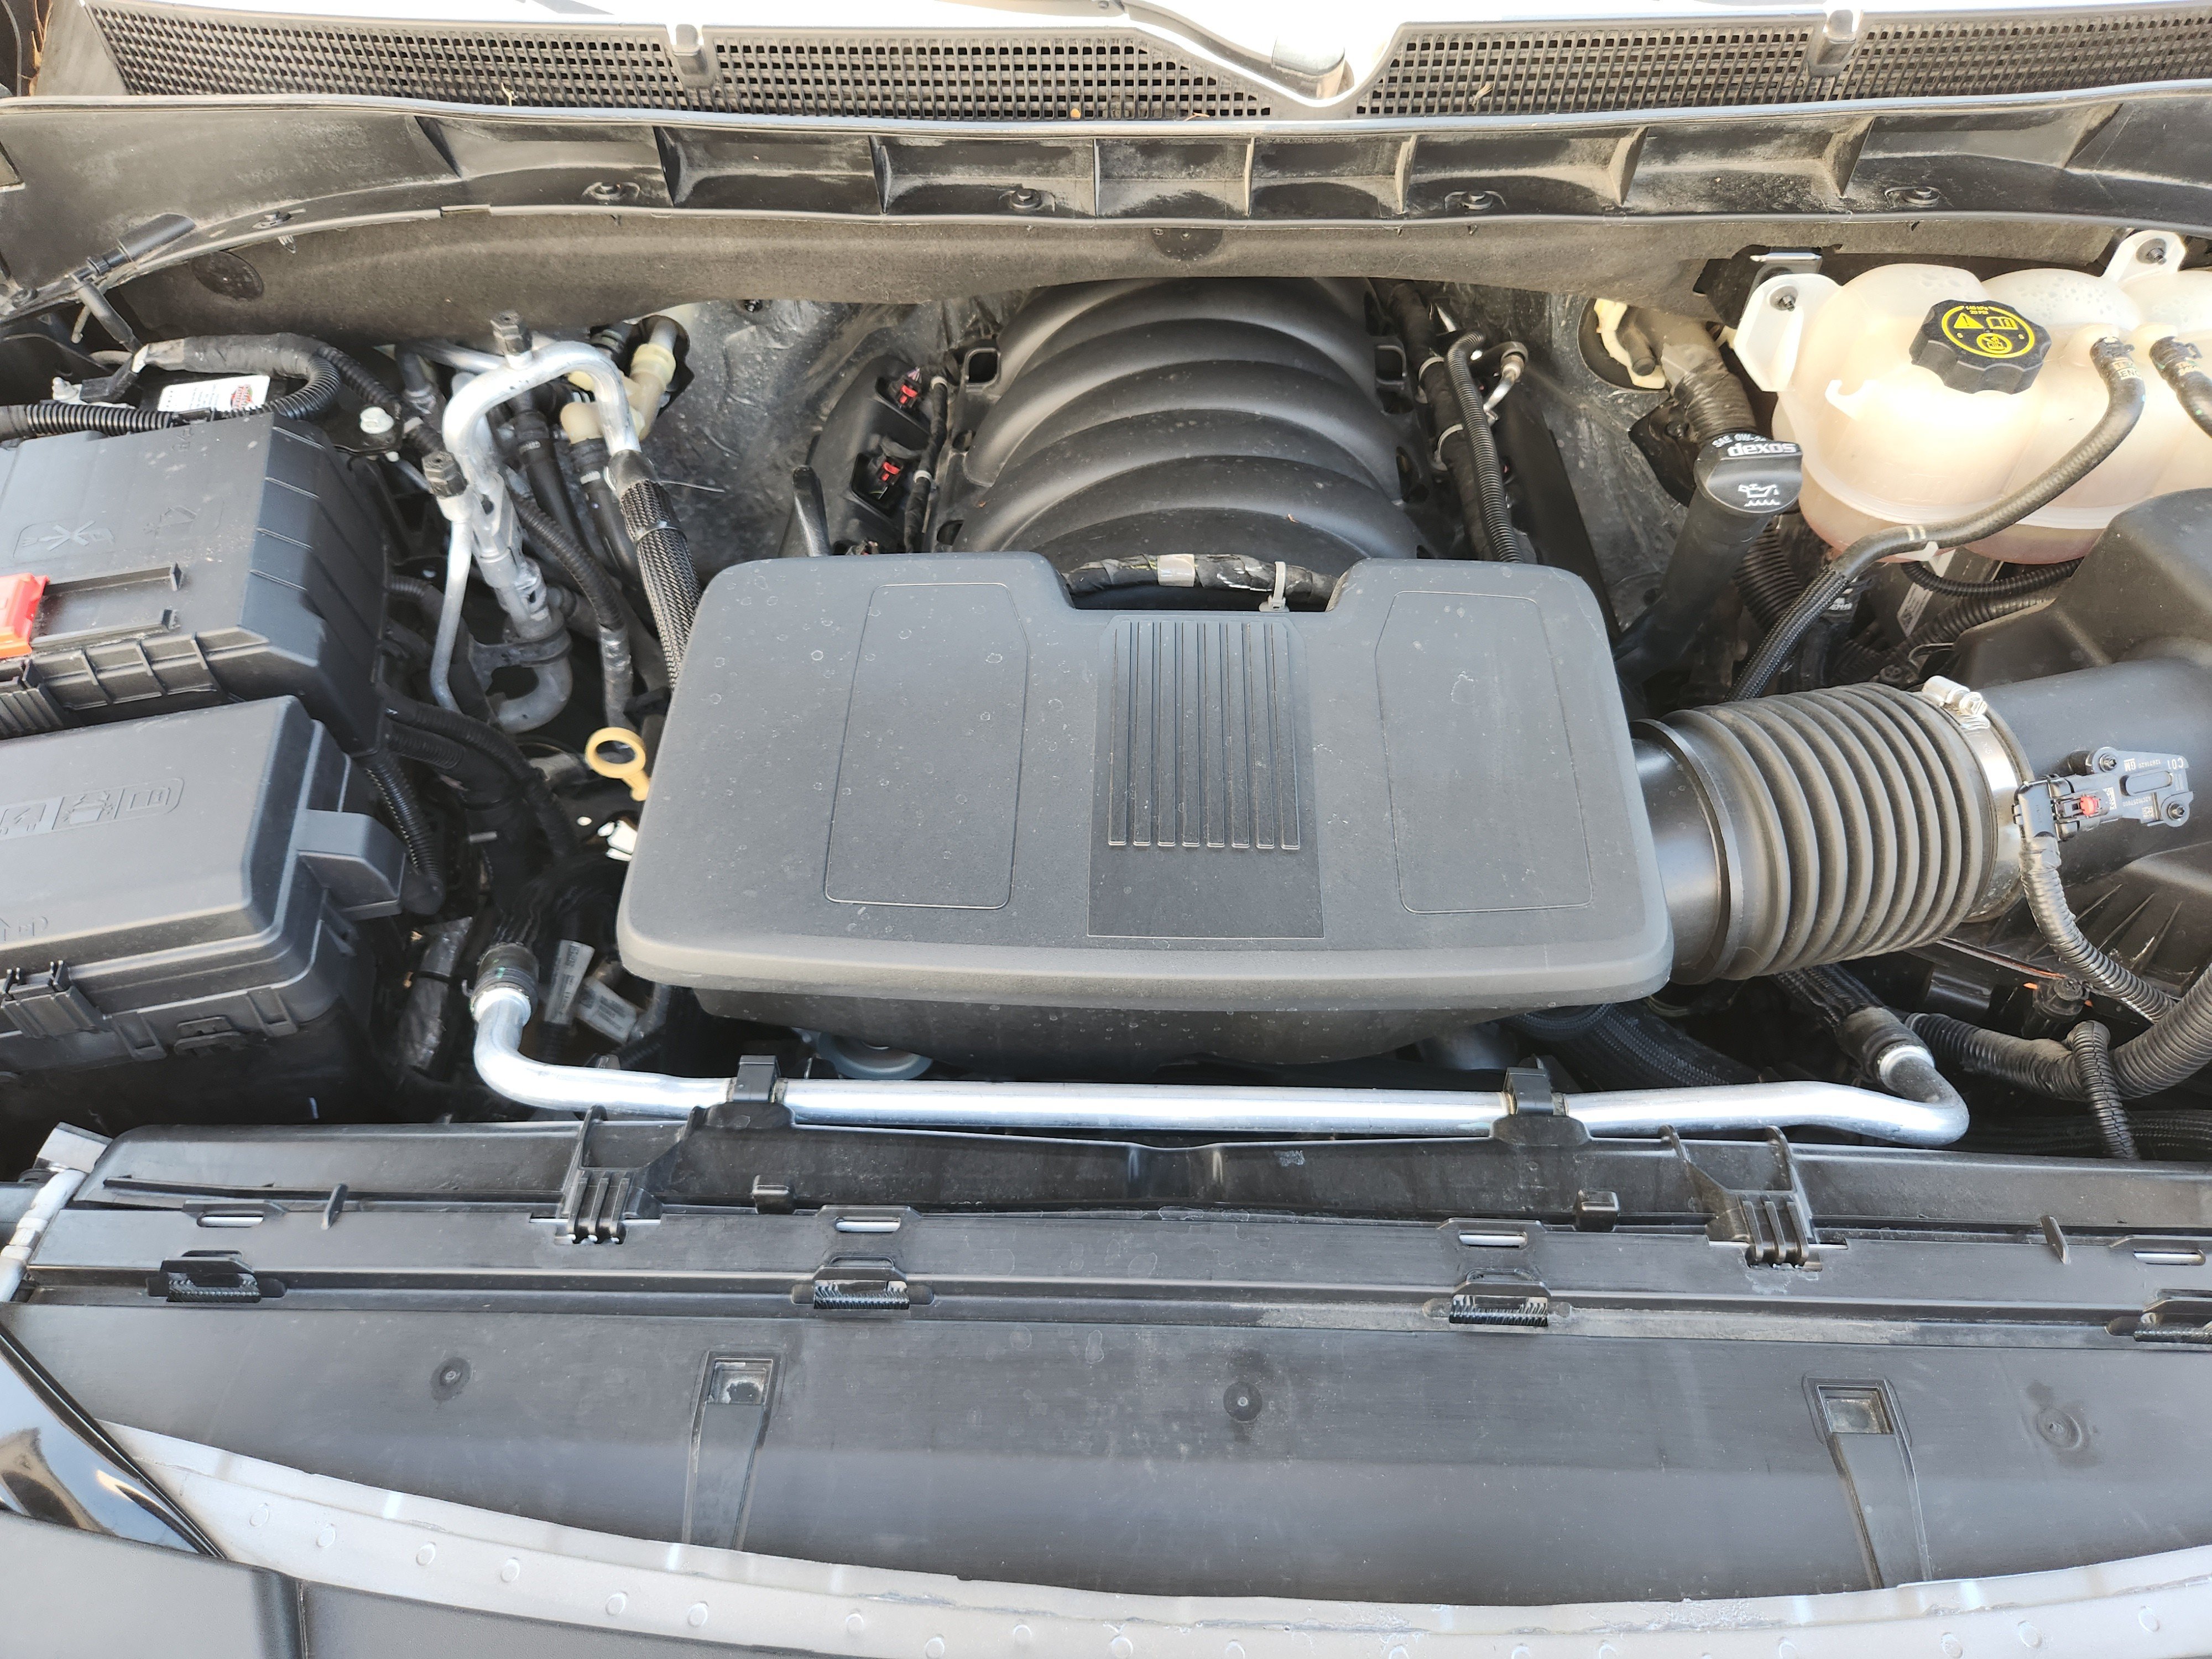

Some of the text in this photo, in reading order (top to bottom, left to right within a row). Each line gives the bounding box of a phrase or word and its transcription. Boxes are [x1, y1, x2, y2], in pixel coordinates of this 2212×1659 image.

[1712, 435, 1733, 448] SAE
[1727, 442, 1797, 457] dexos
[2124, 761, 2136, 772] GM
